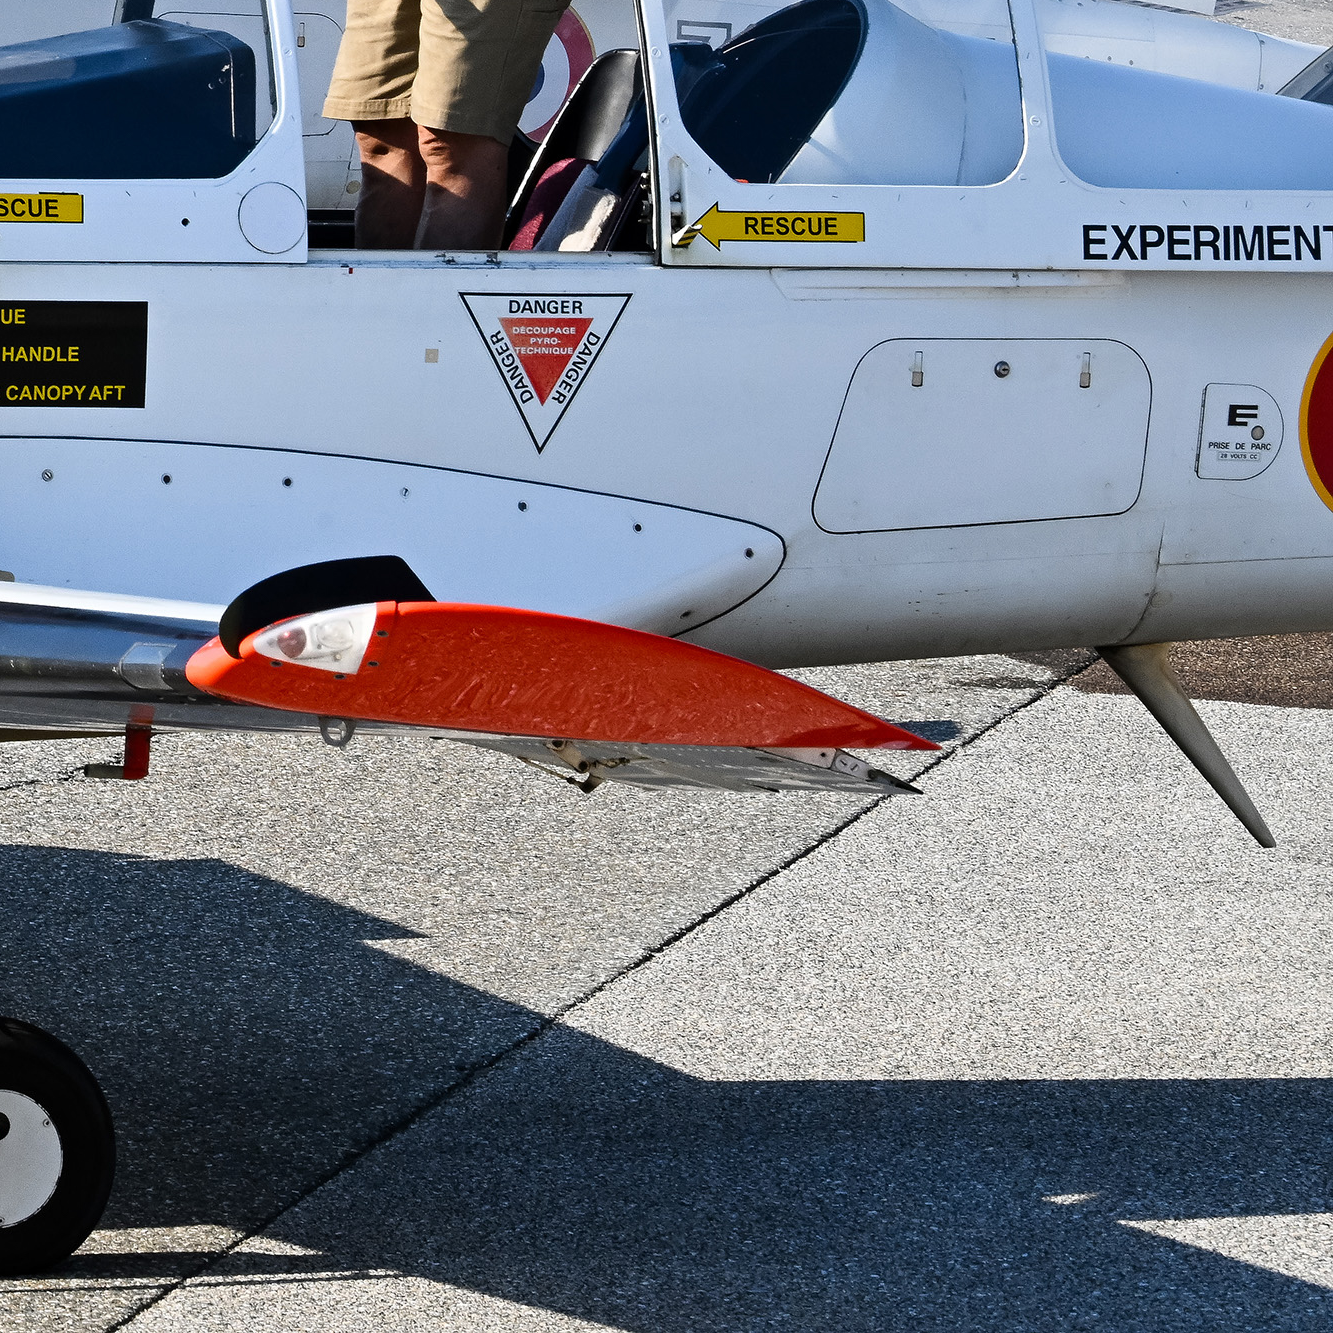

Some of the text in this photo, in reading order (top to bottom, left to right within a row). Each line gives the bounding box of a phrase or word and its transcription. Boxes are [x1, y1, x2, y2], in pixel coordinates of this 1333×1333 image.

[744, 216, 839, 236] RESCUE
[508, 299, 583, 315] DANGER
[530, 337, 562, 345] PYRO-
[1, 346, 80, 362] HANDLE
[513, 346, 574, 356] TECHNIQUE
[489, 330, 535, 405] DANGER
[551, 331, 602, 405] DANGER
[6, 385, 87, 401] CANOPY
[88, 385, 126, 401] AFT
[1208, 441, 1230, 450] PRISE
[1251, 443, 1272, 451] PARC
